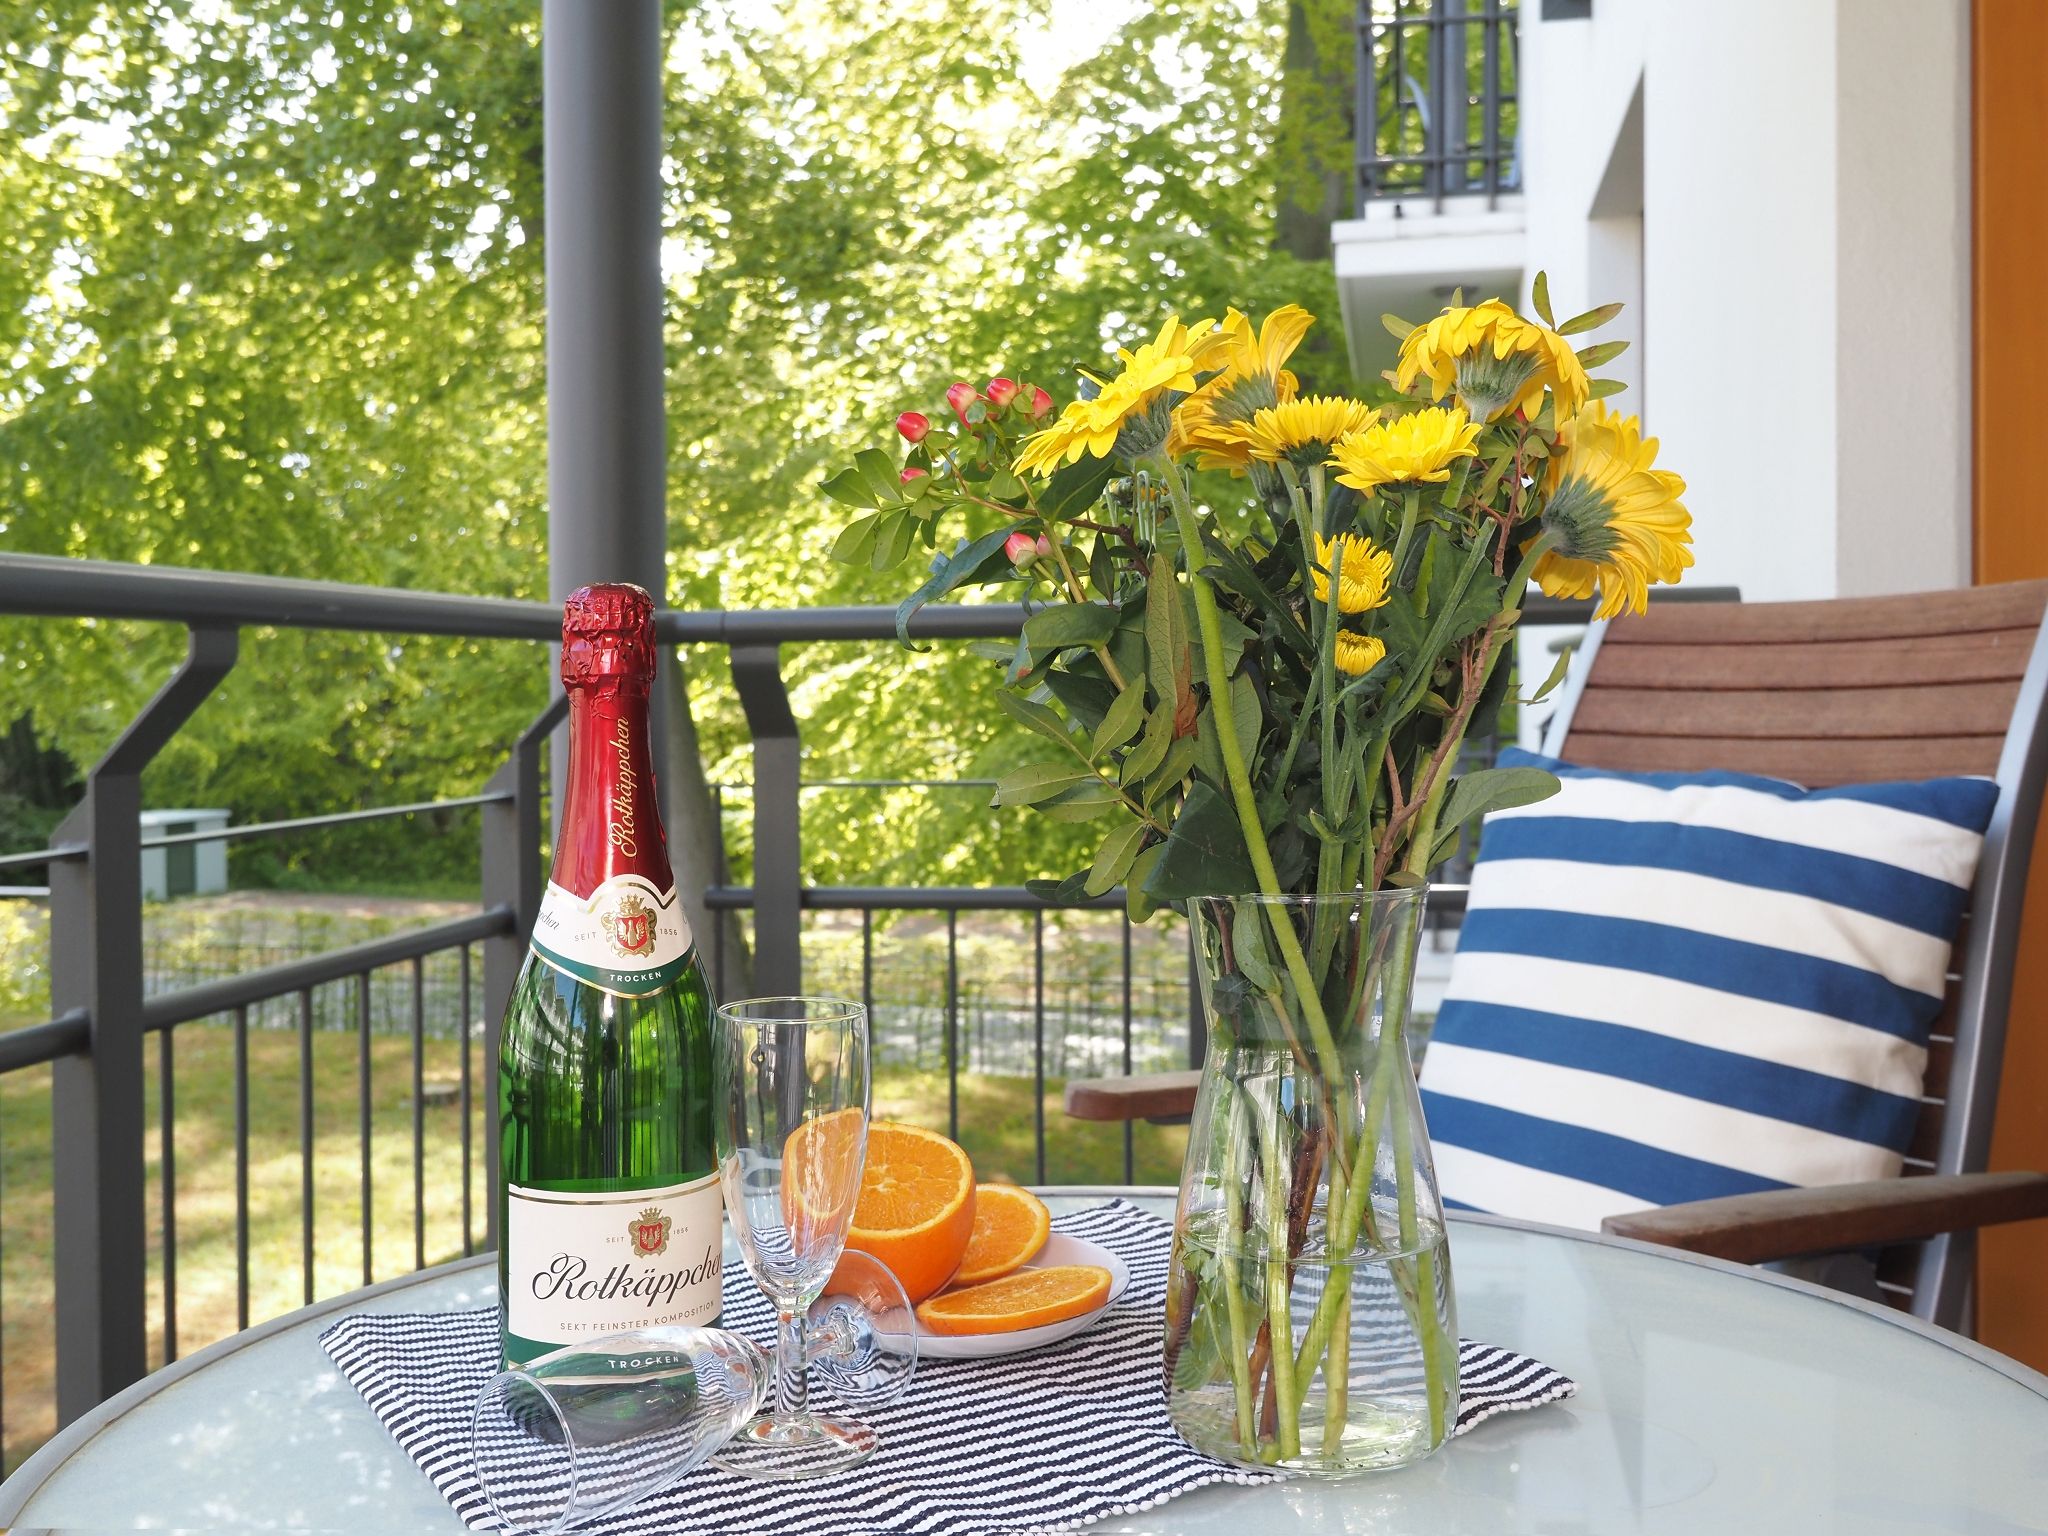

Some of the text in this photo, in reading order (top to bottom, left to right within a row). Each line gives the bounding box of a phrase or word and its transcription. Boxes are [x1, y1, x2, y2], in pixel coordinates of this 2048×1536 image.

[608, 716, 638, 858] Rotkäppchen
[574, 928, 678, 942] SEIT 1856
[610, 971, 662, 982] TROCKEN
[606, 1226, 689, 1244] SEIT 1856
[560, 1300, 714, 1331] SEKT FEINSTER KOMPOSITION
[608, 1355, 679, 1369] TROCKEN
